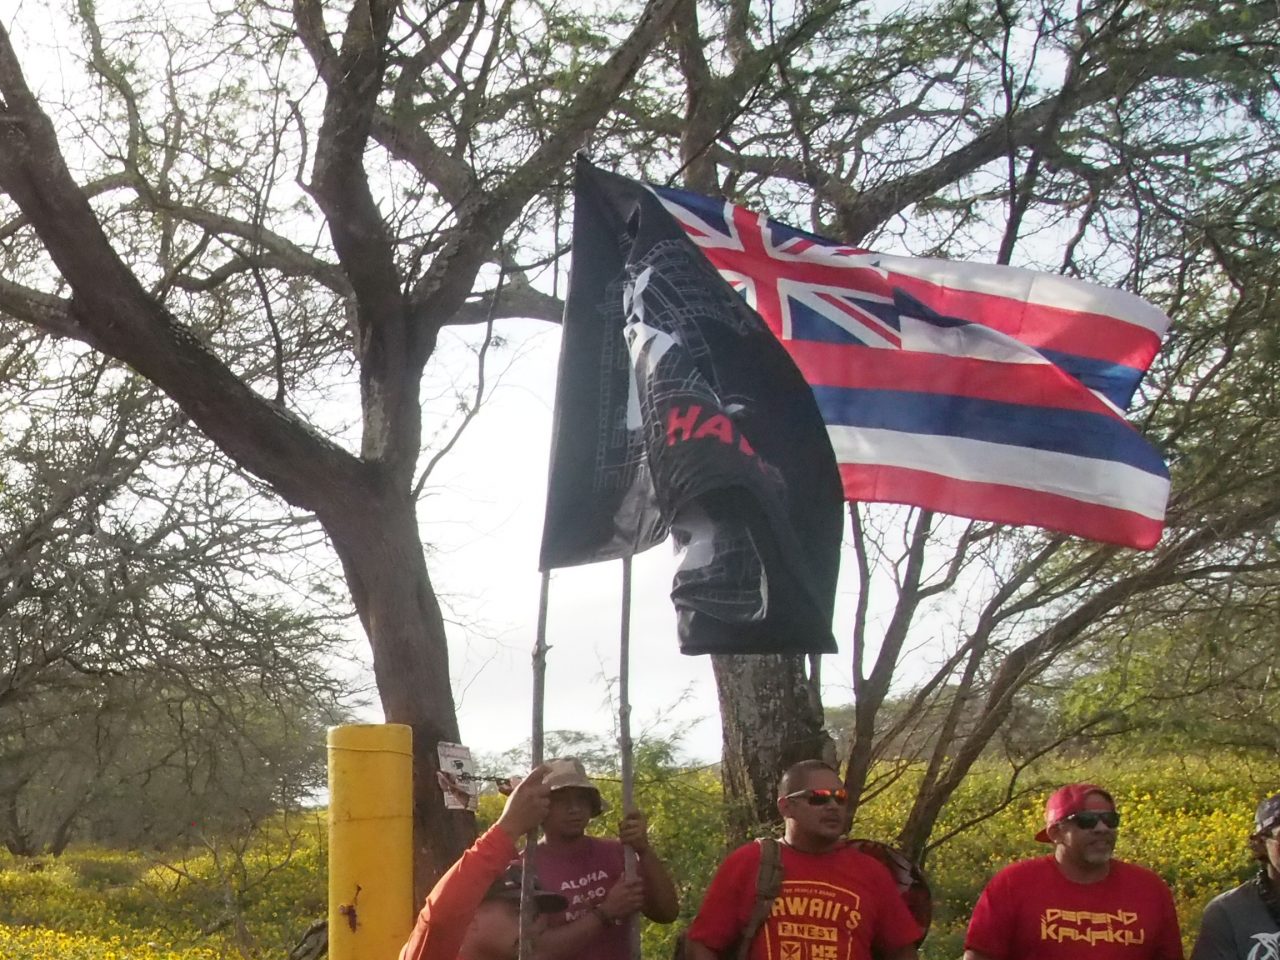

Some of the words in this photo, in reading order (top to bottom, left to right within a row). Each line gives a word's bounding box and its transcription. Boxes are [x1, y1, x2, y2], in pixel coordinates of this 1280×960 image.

[560, 870, 608, 890] ALOHA
[769, 896, 861, 929] AWAII'S
[1045, 909, 1138, 926] DEFEND
[781, 923, 834, 939] FINEST
